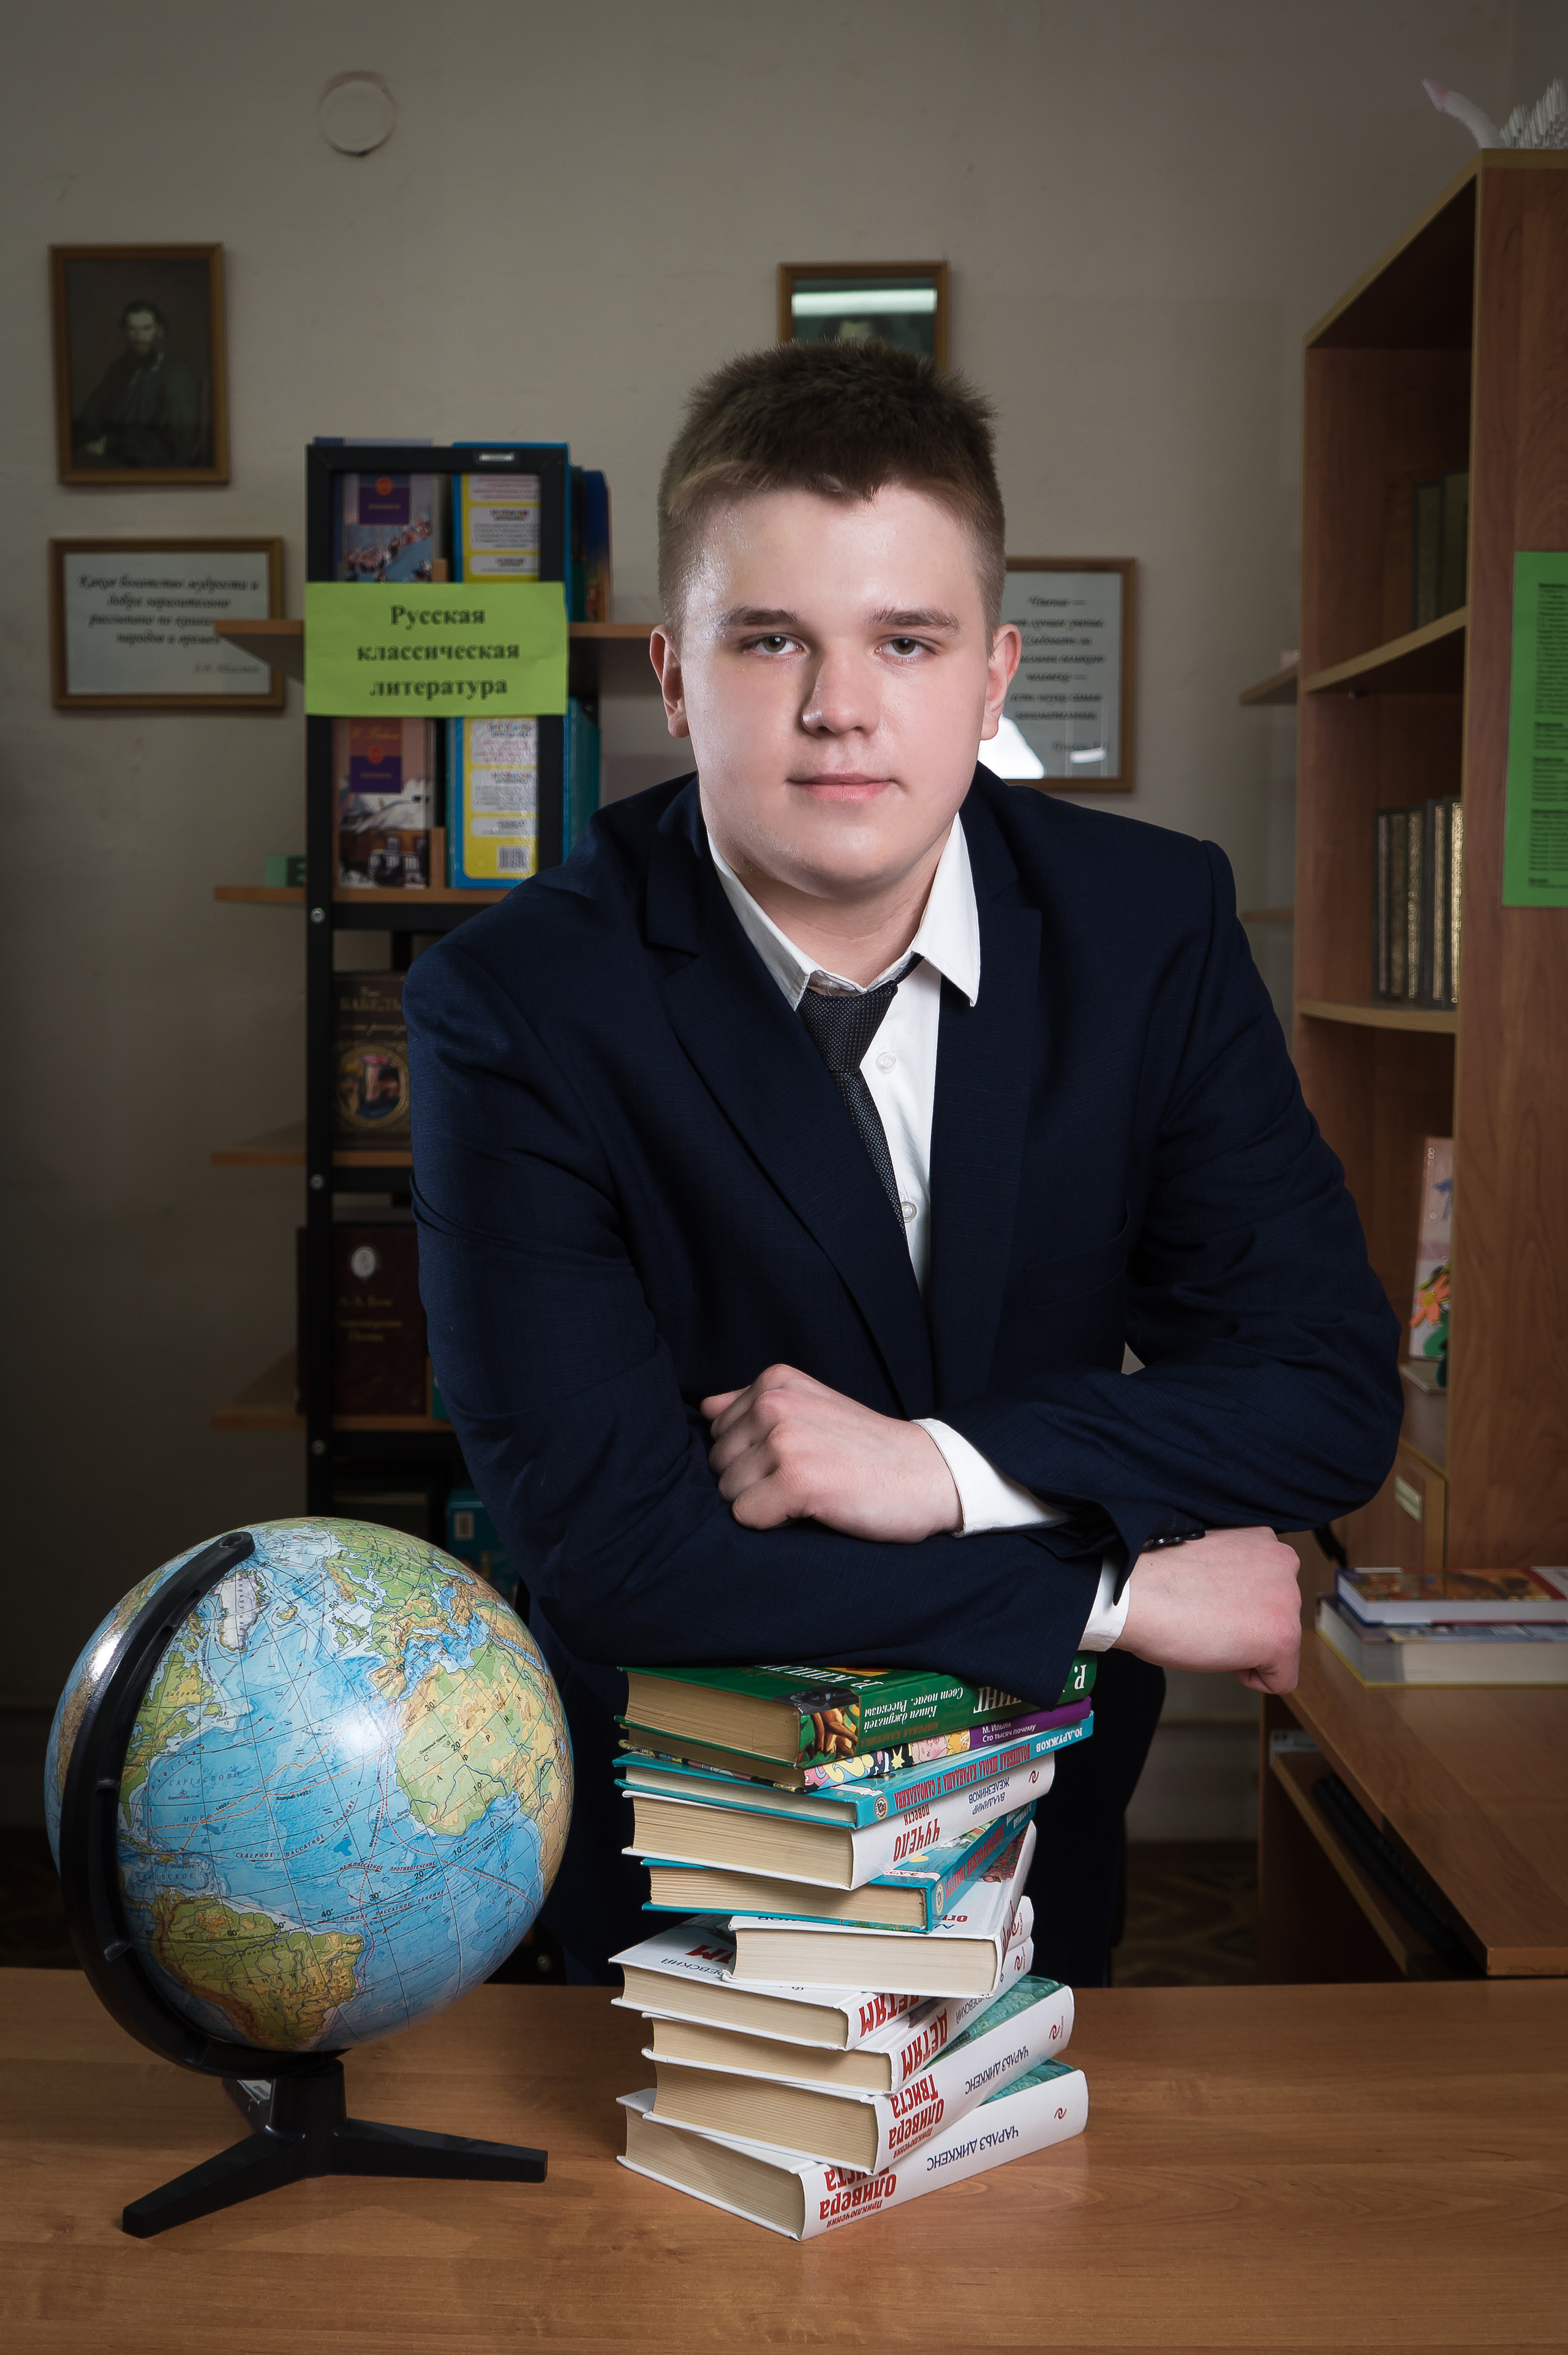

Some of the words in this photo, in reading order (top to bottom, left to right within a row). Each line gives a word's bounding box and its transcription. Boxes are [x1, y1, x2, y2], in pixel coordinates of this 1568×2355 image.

[390, 605, 485, 630] Русская
[356, 644, 519, 661] классическая
[369, 679, 508, 700] литература
[328, 1597, 340, 1609] 60°
[1074, 1664, 1087, 1690] Р.
[911, 1693, 939, 1707] погас.
[940, 1687, 963, 1700] Свет
[864, 1699, 909, 1717] Рассказы
[910, 1705, 938, 1720] Книги
[864, 1713, 908, 1733] джунглей
[902, 1721, 939, 1738] МИРОВАЯ
[991, 1722, 1011, 1732] Ильин
[982, 1735, 993, 1743] Сто
[993, 1730, 1012, 1741] тысяч
[1012, 1724, 1036, 1737] почему
[451, 1739, 461, 1752] 20°
[979, 1754, 998, 1777] ШКОЛА
[1000, 1744, 1030, 1771] ВОЛШЕБНАЯ
[169, 1772, 239, 1786] САРГАССОВО
[473, 1779, 484, 1792] 10°
[943, 1763, 977, 1792] КАРАНДАША
[894, 1780, 935, 1811] САМОДЕЛКИНА
[938, 1780, 941, 1795] И
[968, 1777, 1010, 1804] ЖЕЛЕЗНИКОВ
[973, 1792, 1005, 1815] ВЛАДИМИР
[285, 1833, 324, 1857] ПАССАТНОЕ
[453, 1844, 463, 1856] 10°
[893, 1818, 940, 1863] ЧУЧЕЛО
[339, 1863, 383, 1872] МЕЖПАССАТНОЕ
[390, 1861, 435, 1872] ПРОТИВОТЕЧЕНИЕ
[414, 1869, 426, 1880] 20°
[369, 1891, 381, 1901] 30°
[375, 1902, 411, 1915] ПАССАТНОЕ
[418, 1890, 444, 1903] ТЕЧЕНИЕ
[321, 1908, 333, 1918] 40°
[900, 2008, 948, 2082] ДЕТЯМ
[1001, 2046, 1029, 2072] ЧАРЛЬЗ
[965, 2060, 1000, 2095] ДИККЕНС
[980, 2125, 1019, 2150] ЧАРЛЬЗ
[927, 2139, 978, 2171] ДИККЕНС
